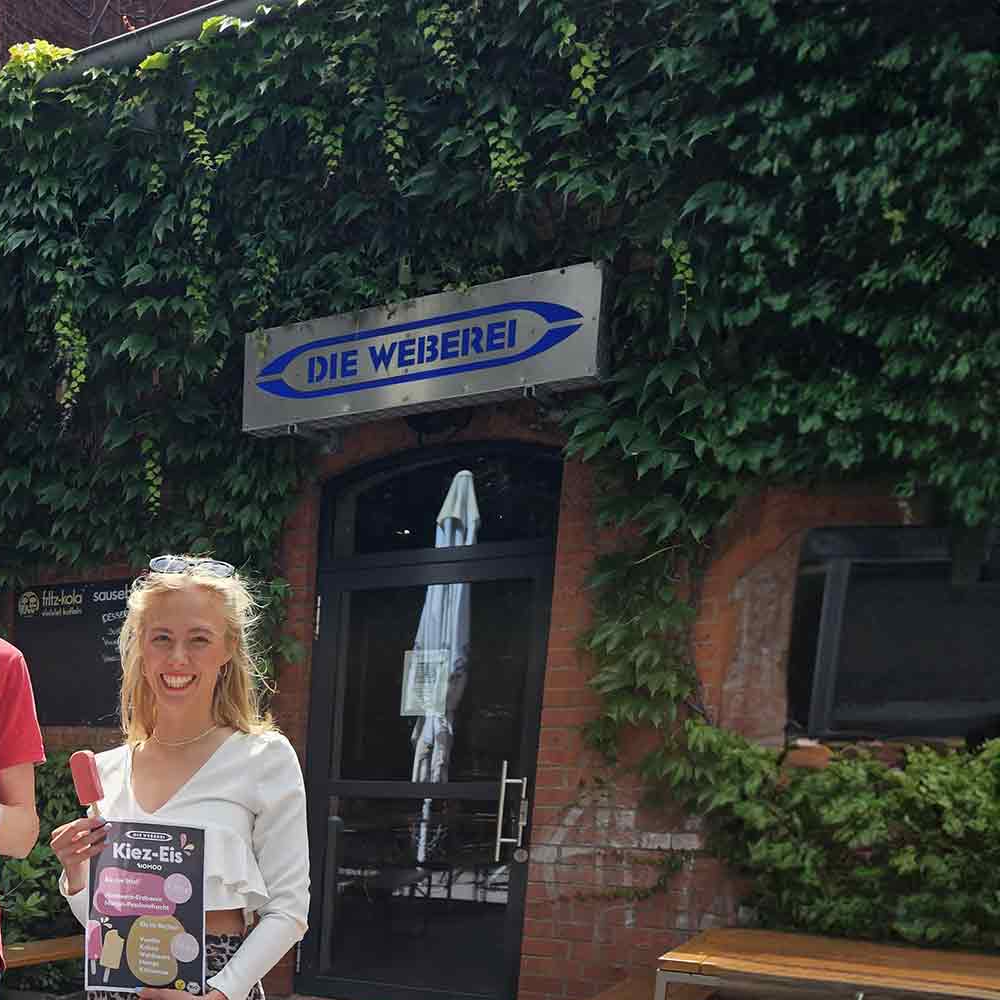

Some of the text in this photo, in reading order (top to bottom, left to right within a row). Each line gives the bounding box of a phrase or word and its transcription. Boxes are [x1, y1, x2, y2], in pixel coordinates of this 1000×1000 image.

[307, 319, 517, 384] DIE WEBEREI
[112, 842, 184, 864] Kiez-Eis
